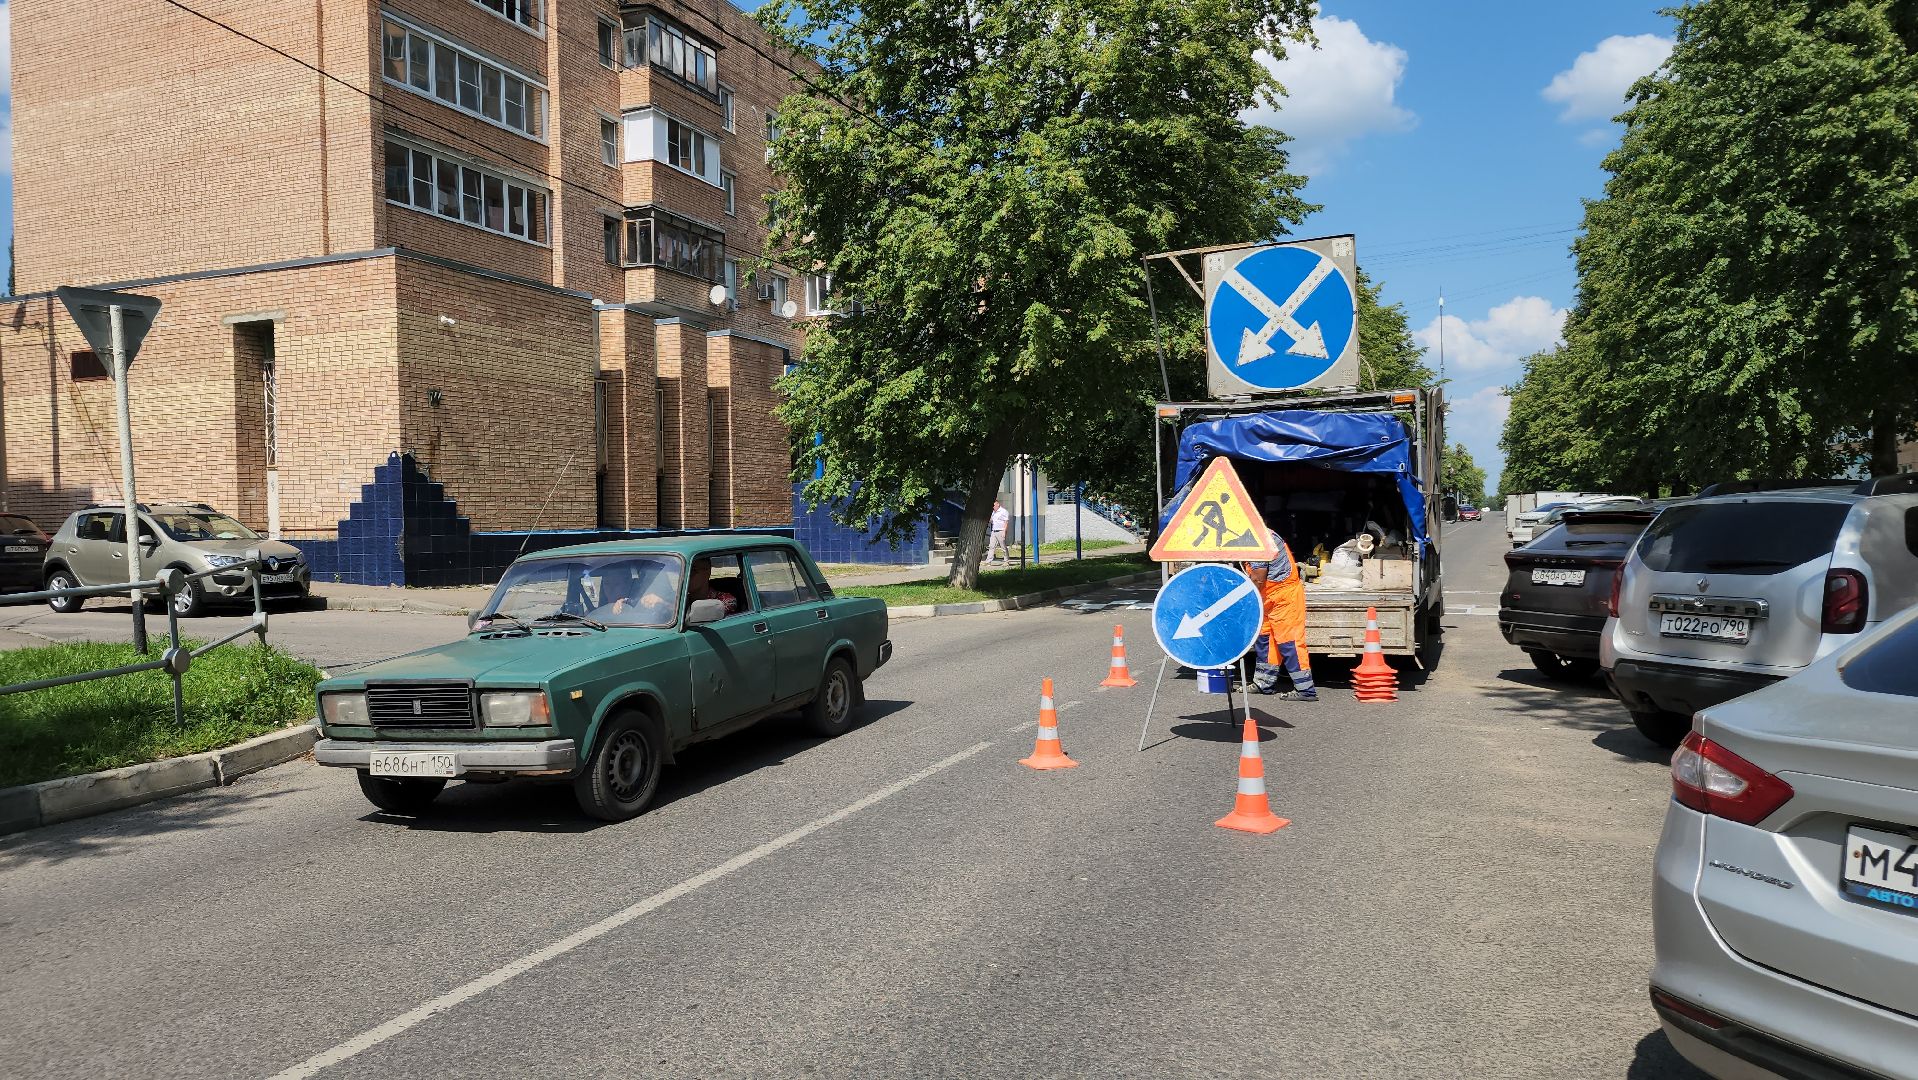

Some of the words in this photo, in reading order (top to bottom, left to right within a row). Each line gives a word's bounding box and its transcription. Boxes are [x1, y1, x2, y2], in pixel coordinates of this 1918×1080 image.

[1666, 617, 1720, 634] Т022РО
[1722, 619, 1745, 632] 790
[375, 756, 427, 773] В686НТ
[430, 755, 452, 769] 150
[1866, 888, 1915, 908] АВТО
